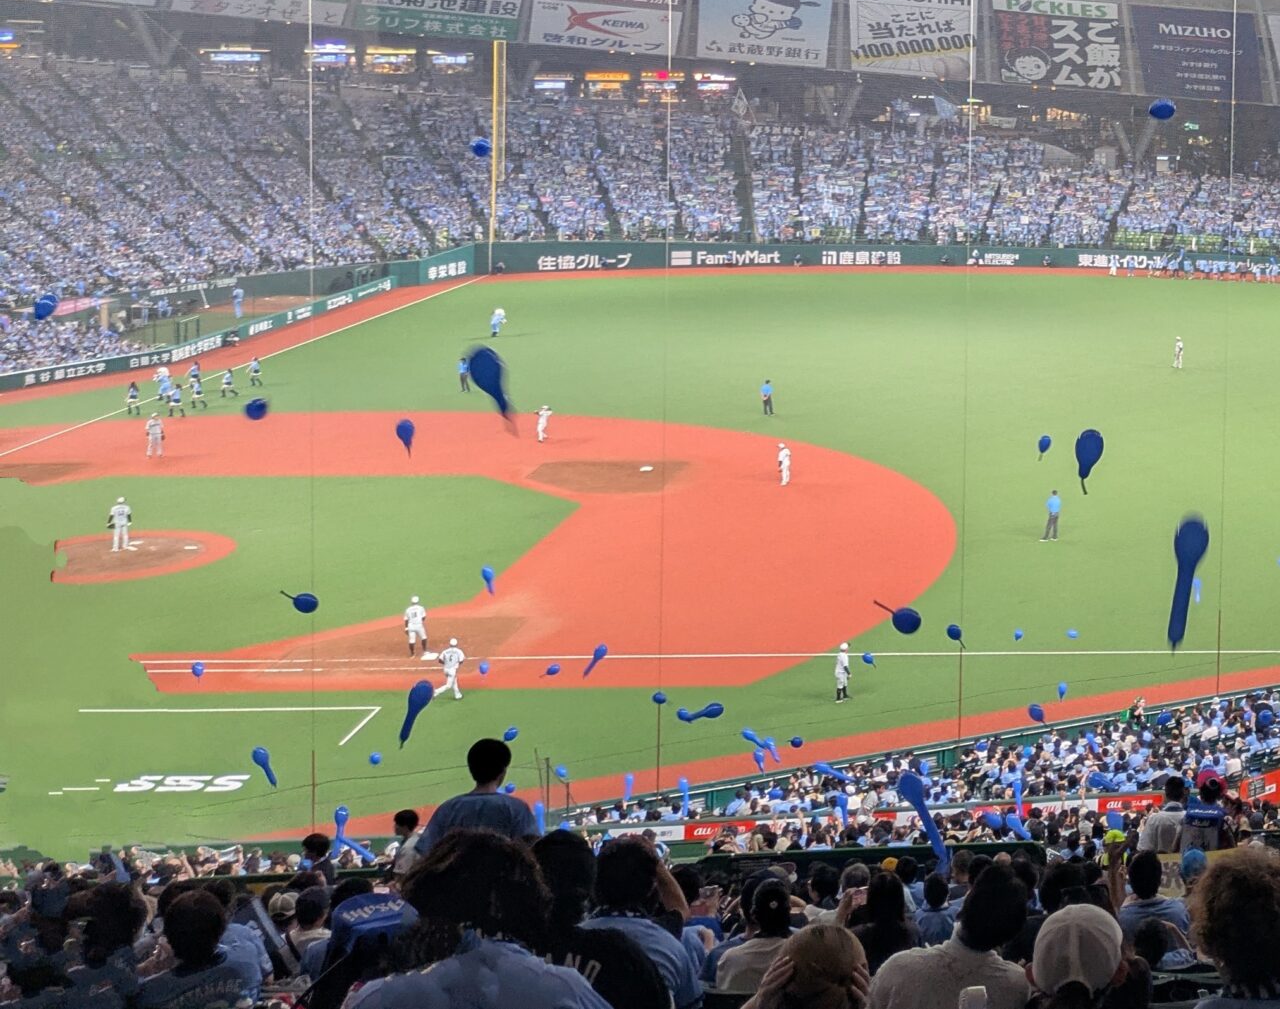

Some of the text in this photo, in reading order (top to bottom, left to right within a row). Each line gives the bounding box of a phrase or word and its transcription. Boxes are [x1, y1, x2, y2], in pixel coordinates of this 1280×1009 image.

[364, 14, 509, 39] クリフ株式会社
[601, 18, 645, 31] KEIWA
[890, 10, 936, 23] ここに
[867, 19, 957, 40] 当たれば
[1158, 23, 1232, 39] MIZUHO
[542, 32, 665, 52] 啓和グループ
[728, 42, 823, 61] 武蔵野銀行
[1049, 19, 1087, 87] ススム
[1084, 20, 1122, 90] ご飯が
[537, 252, 633, 272] 住協グループ
